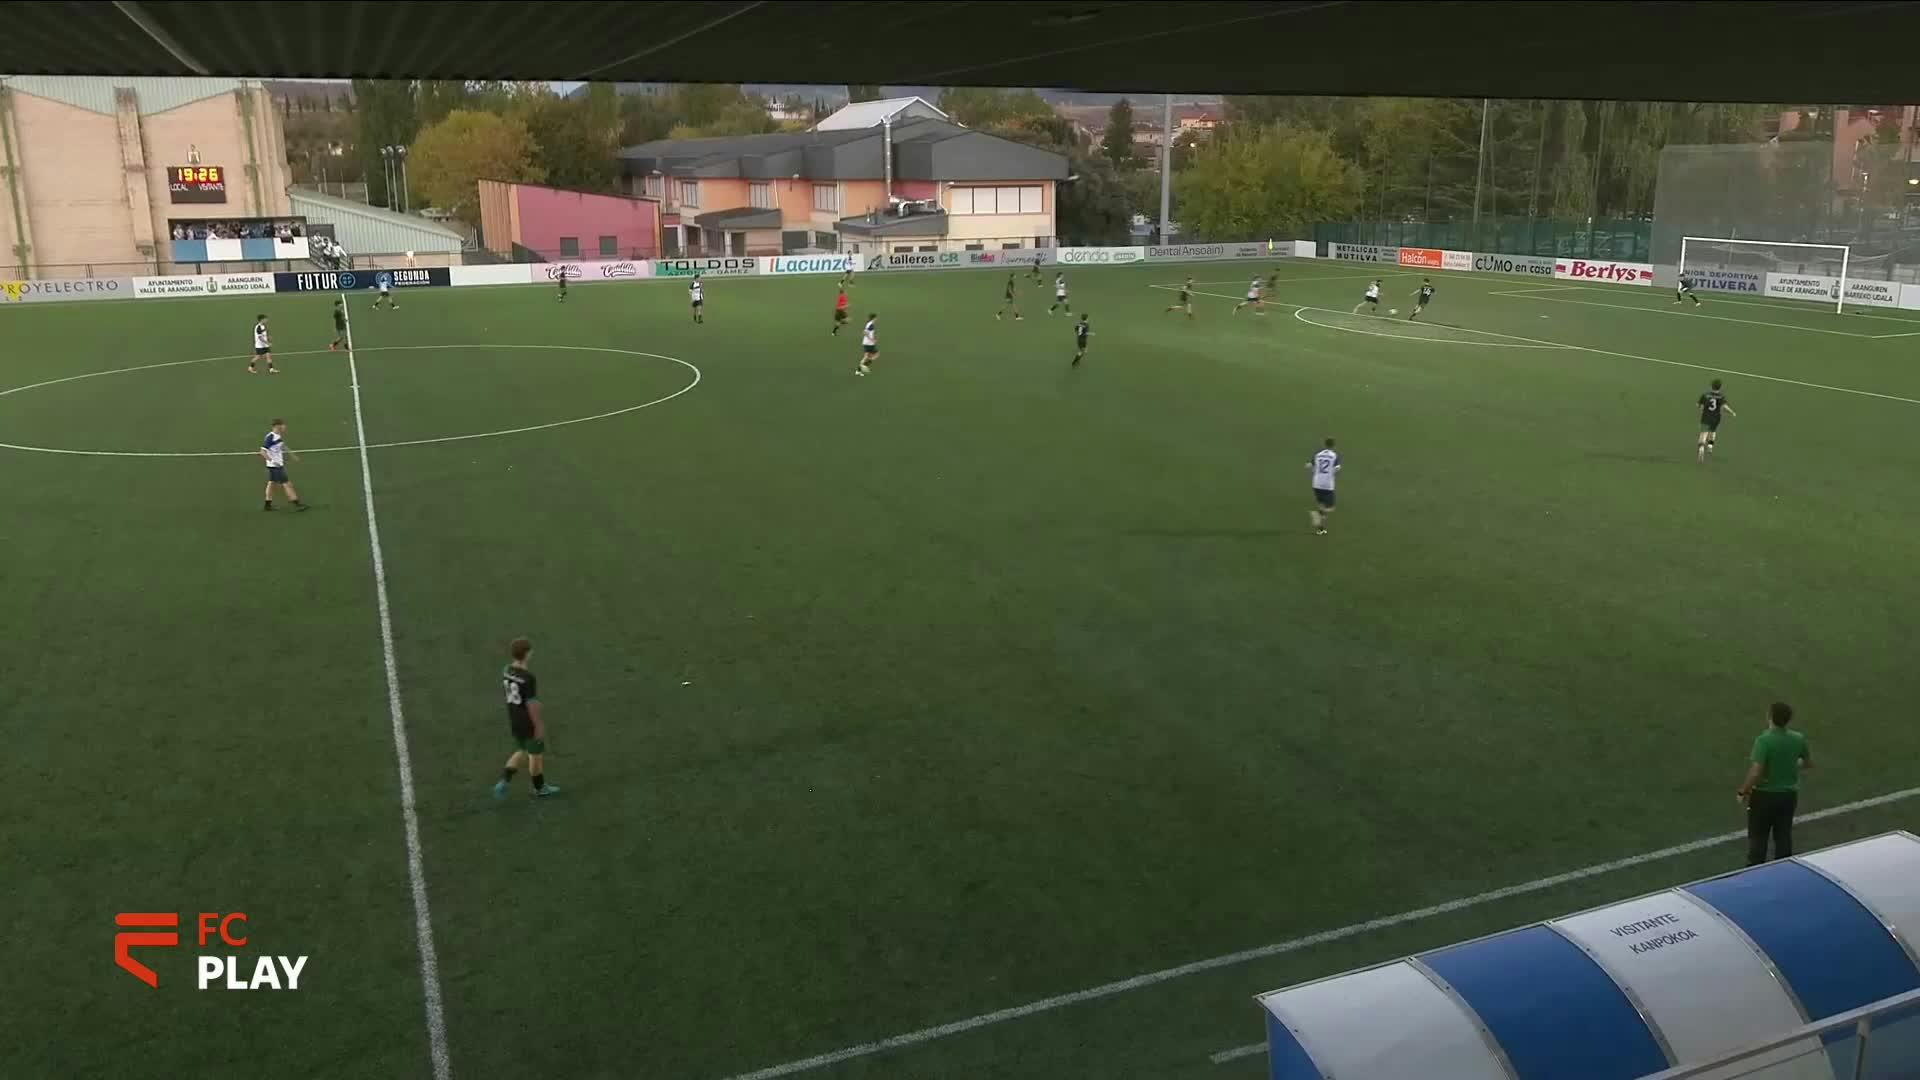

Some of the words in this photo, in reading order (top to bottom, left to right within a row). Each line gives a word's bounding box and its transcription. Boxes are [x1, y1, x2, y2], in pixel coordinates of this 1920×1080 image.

[177, 167, 218, 182] 19:26
[170, 183, 189, 191] LOCAL
[1149, 247, 1179, 257] Dental
[1336, 243, 1378, 254] METALICAS
[889, 254, 935, 264] talleres
[940, 252, 959, 263] CR
[1336, 252, 1378, 262] MUTILVA
[1401, 250, 1427, 265] Halcón
[660, 258, 755, 271] TOLDOS
[1515, 264, 1527, 272] en
[1530, 264, 1552, 275] casa
[393, 270, 430, 281] SEGUNDA
[1570, 261, 1637, 282] Berlys
[1709, 271, 1759, 280] DEPORTIVA
[148, 279, 193, 287] AYUNTAMIENTO
[227, 276, 263, 284] ARANGUREN
[297, 272, 339, 290] FUTUR
[1779, 277, 1820, 288] AYUNTAMIENTO
[167, 285, 204, 293] ARANGUREN
[1794, 287, 1828, 296] ARANGUREN
[1851, 283, 1888, 293] ARANGUREN
[1708, 398, 1717, 411] 3
[1318, 459, 1330, 474] 12
[1609, 912, 1680, 937] VISITANTE
[1628, 929, 1699, 955] KANPOKOA
